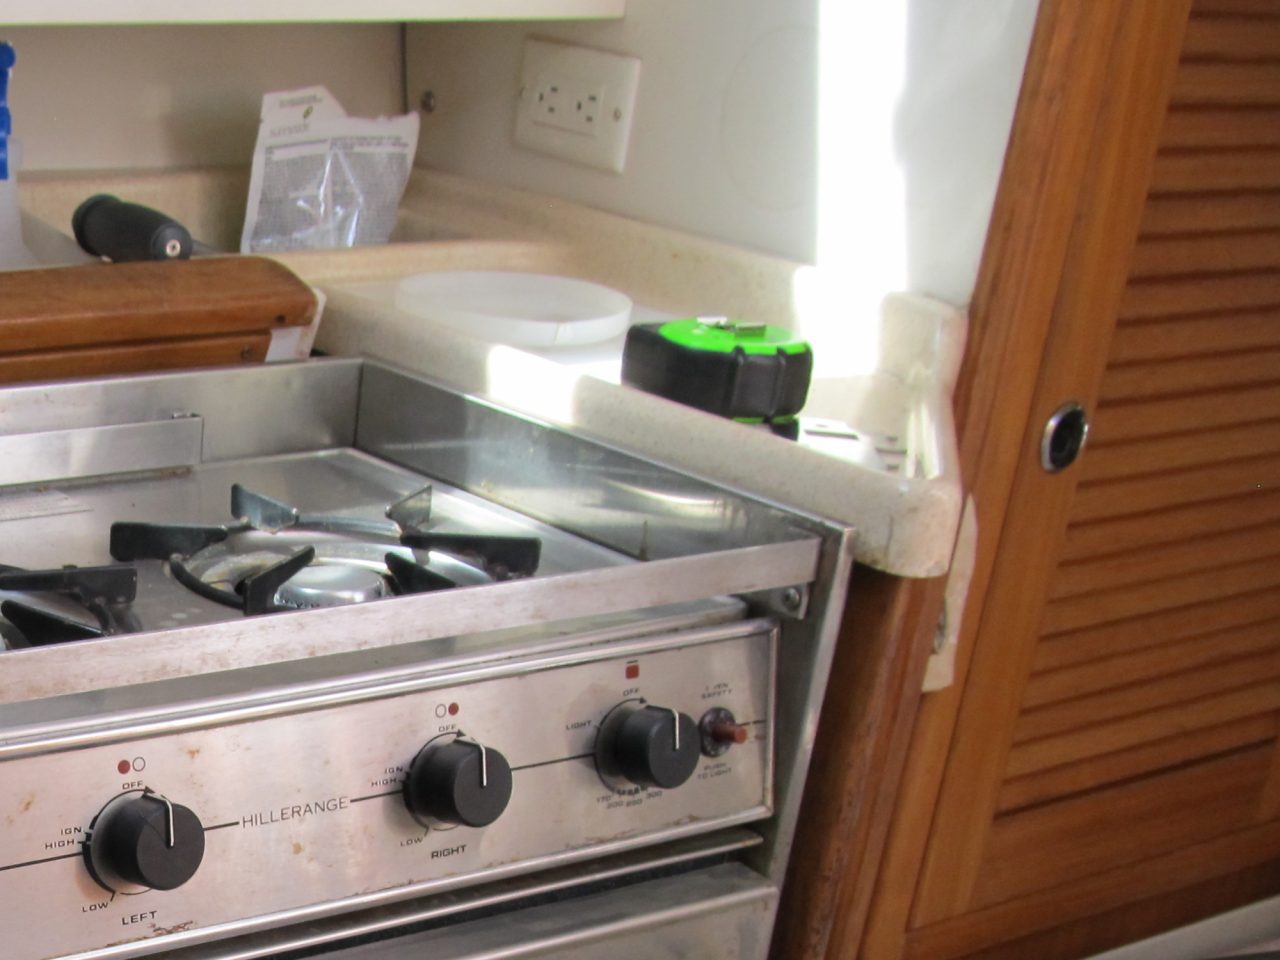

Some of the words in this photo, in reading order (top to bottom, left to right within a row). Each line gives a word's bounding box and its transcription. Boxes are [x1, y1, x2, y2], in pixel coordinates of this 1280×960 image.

[438, 724, 457, 733] OFF
[566, 719, 592, 731] LIGHT
[384, 766, 404, 775] IGN
[122, 780, 143, 790] OFF
[371, 778, 398, 788] HIGH
[242, 796, 349, 829] HILLERANGE
[60, 826, 82, 836] IGN
[44, 839, 75, 850] HIGH
[400, 836, 423, 847] LOW
[431, 844, 468, 860] RIGHT
[82, 902, 109, 913] LOW
[122, 910, 158, 926] LEFT
